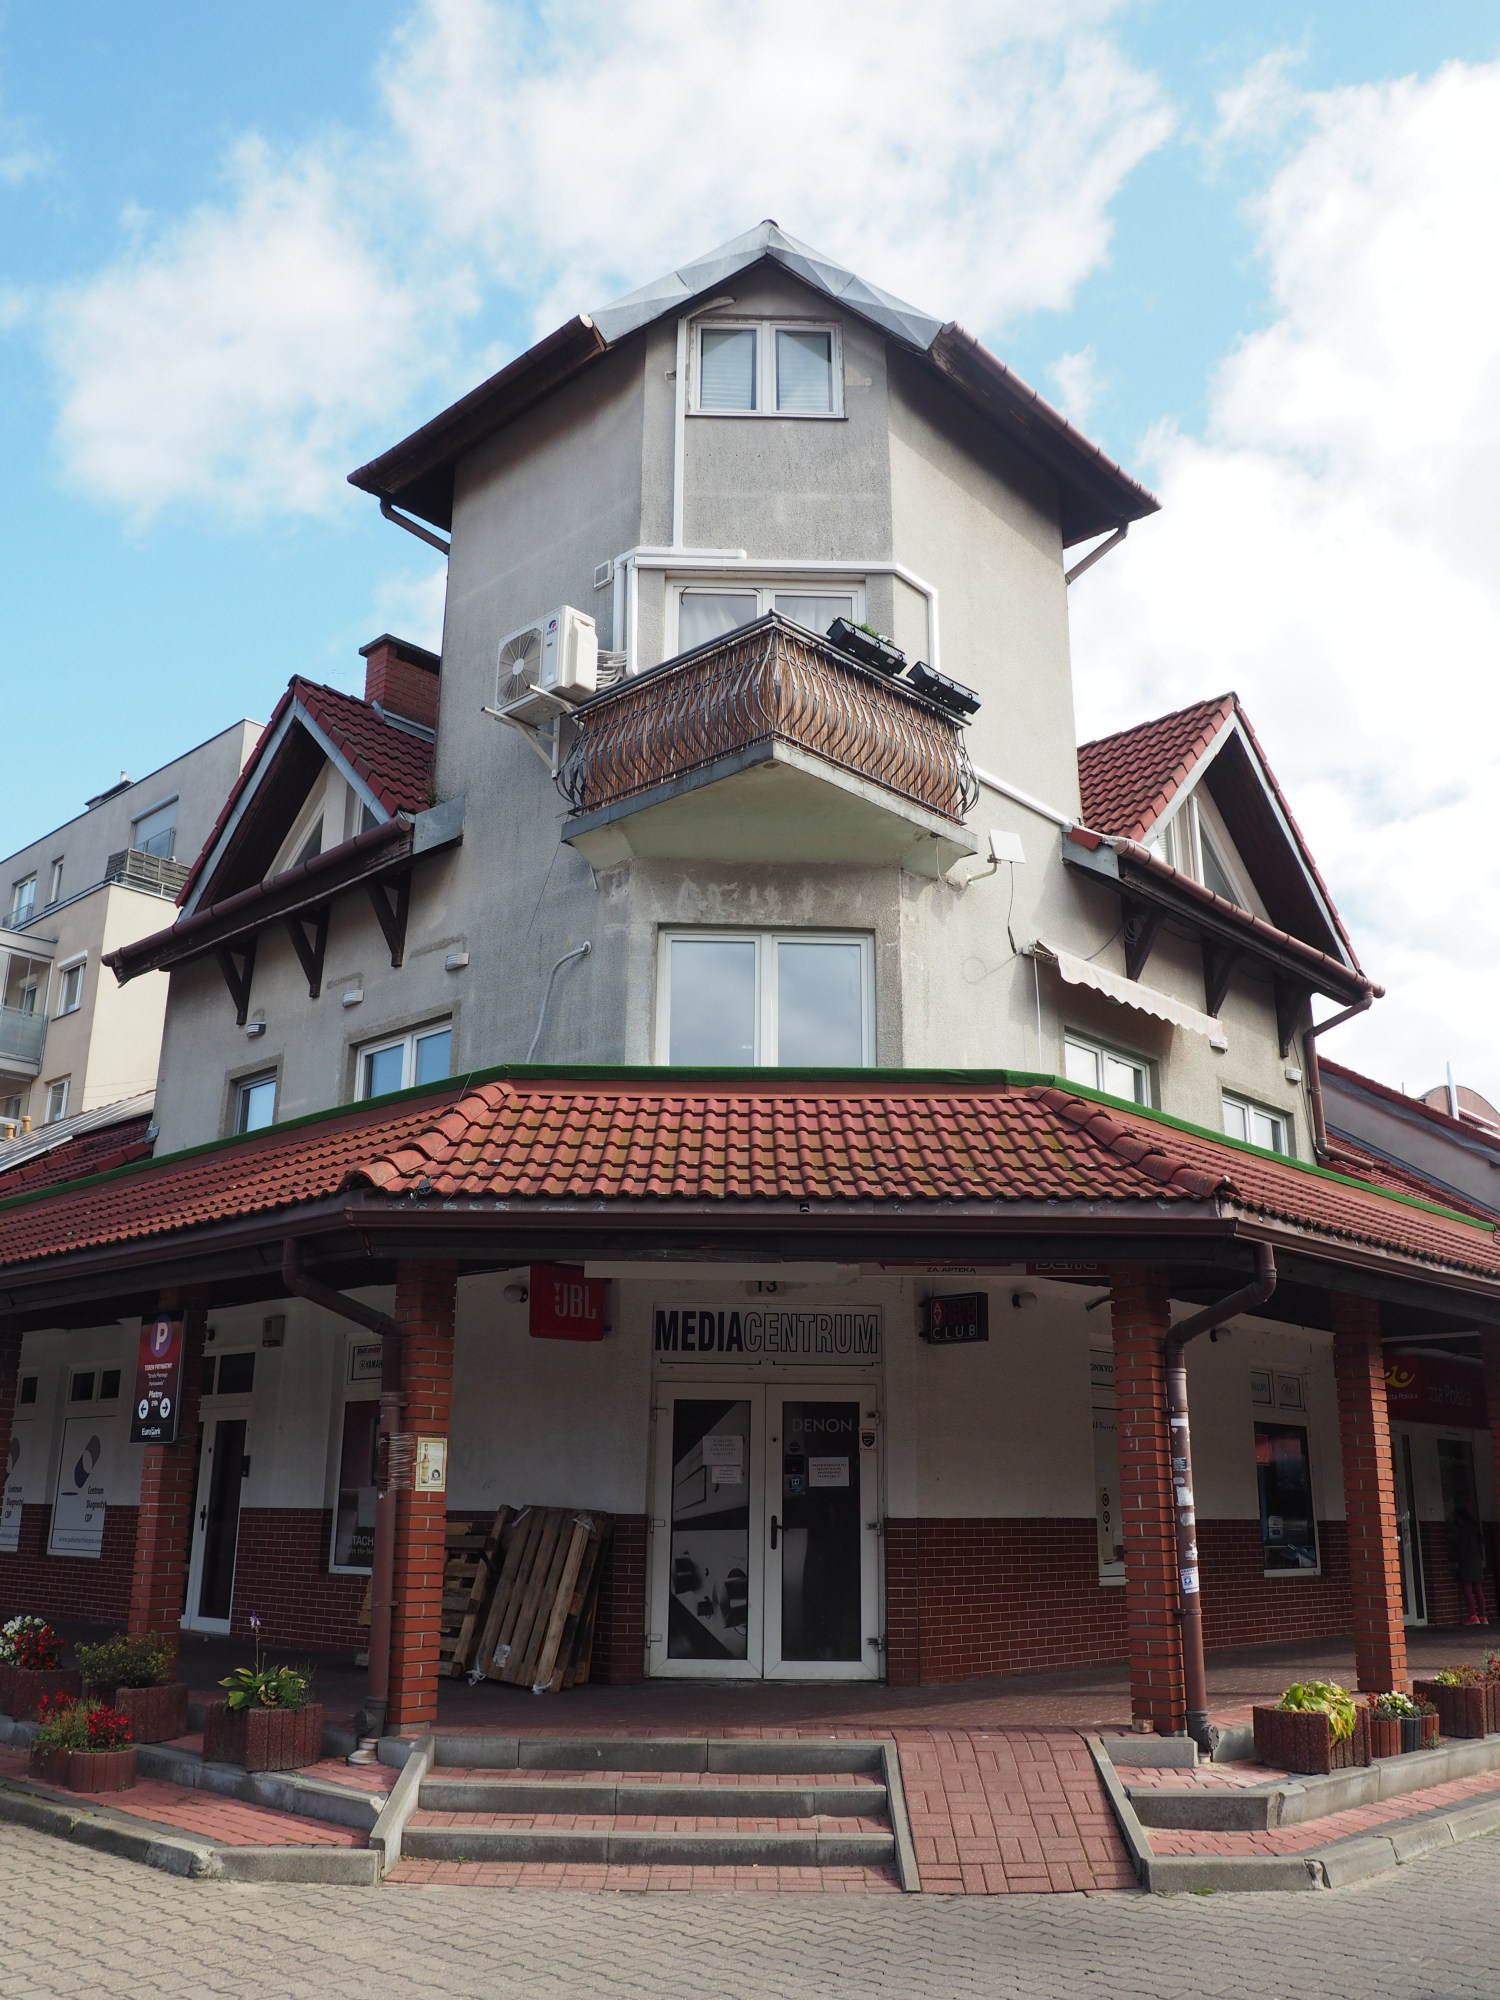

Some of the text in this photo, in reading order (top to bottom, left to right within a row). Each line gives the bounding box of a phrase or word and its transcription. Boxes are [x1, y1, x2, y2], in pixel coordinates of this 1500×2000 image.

[942, 1267, 976, 1275] APTEKĄ
[155, 1322, 169, 1351] P
[654, 1310, 878, 1354] MEDIACENTRUM
[933, 1325, 976, 1339] CLUB
[1398, 1392, 1418, 1400] Polska
[792, 1418, 853, 1433] DENON
[87, 1486, 105, 1495] Centrum
[84, 1513, 93, 1523] CDP
